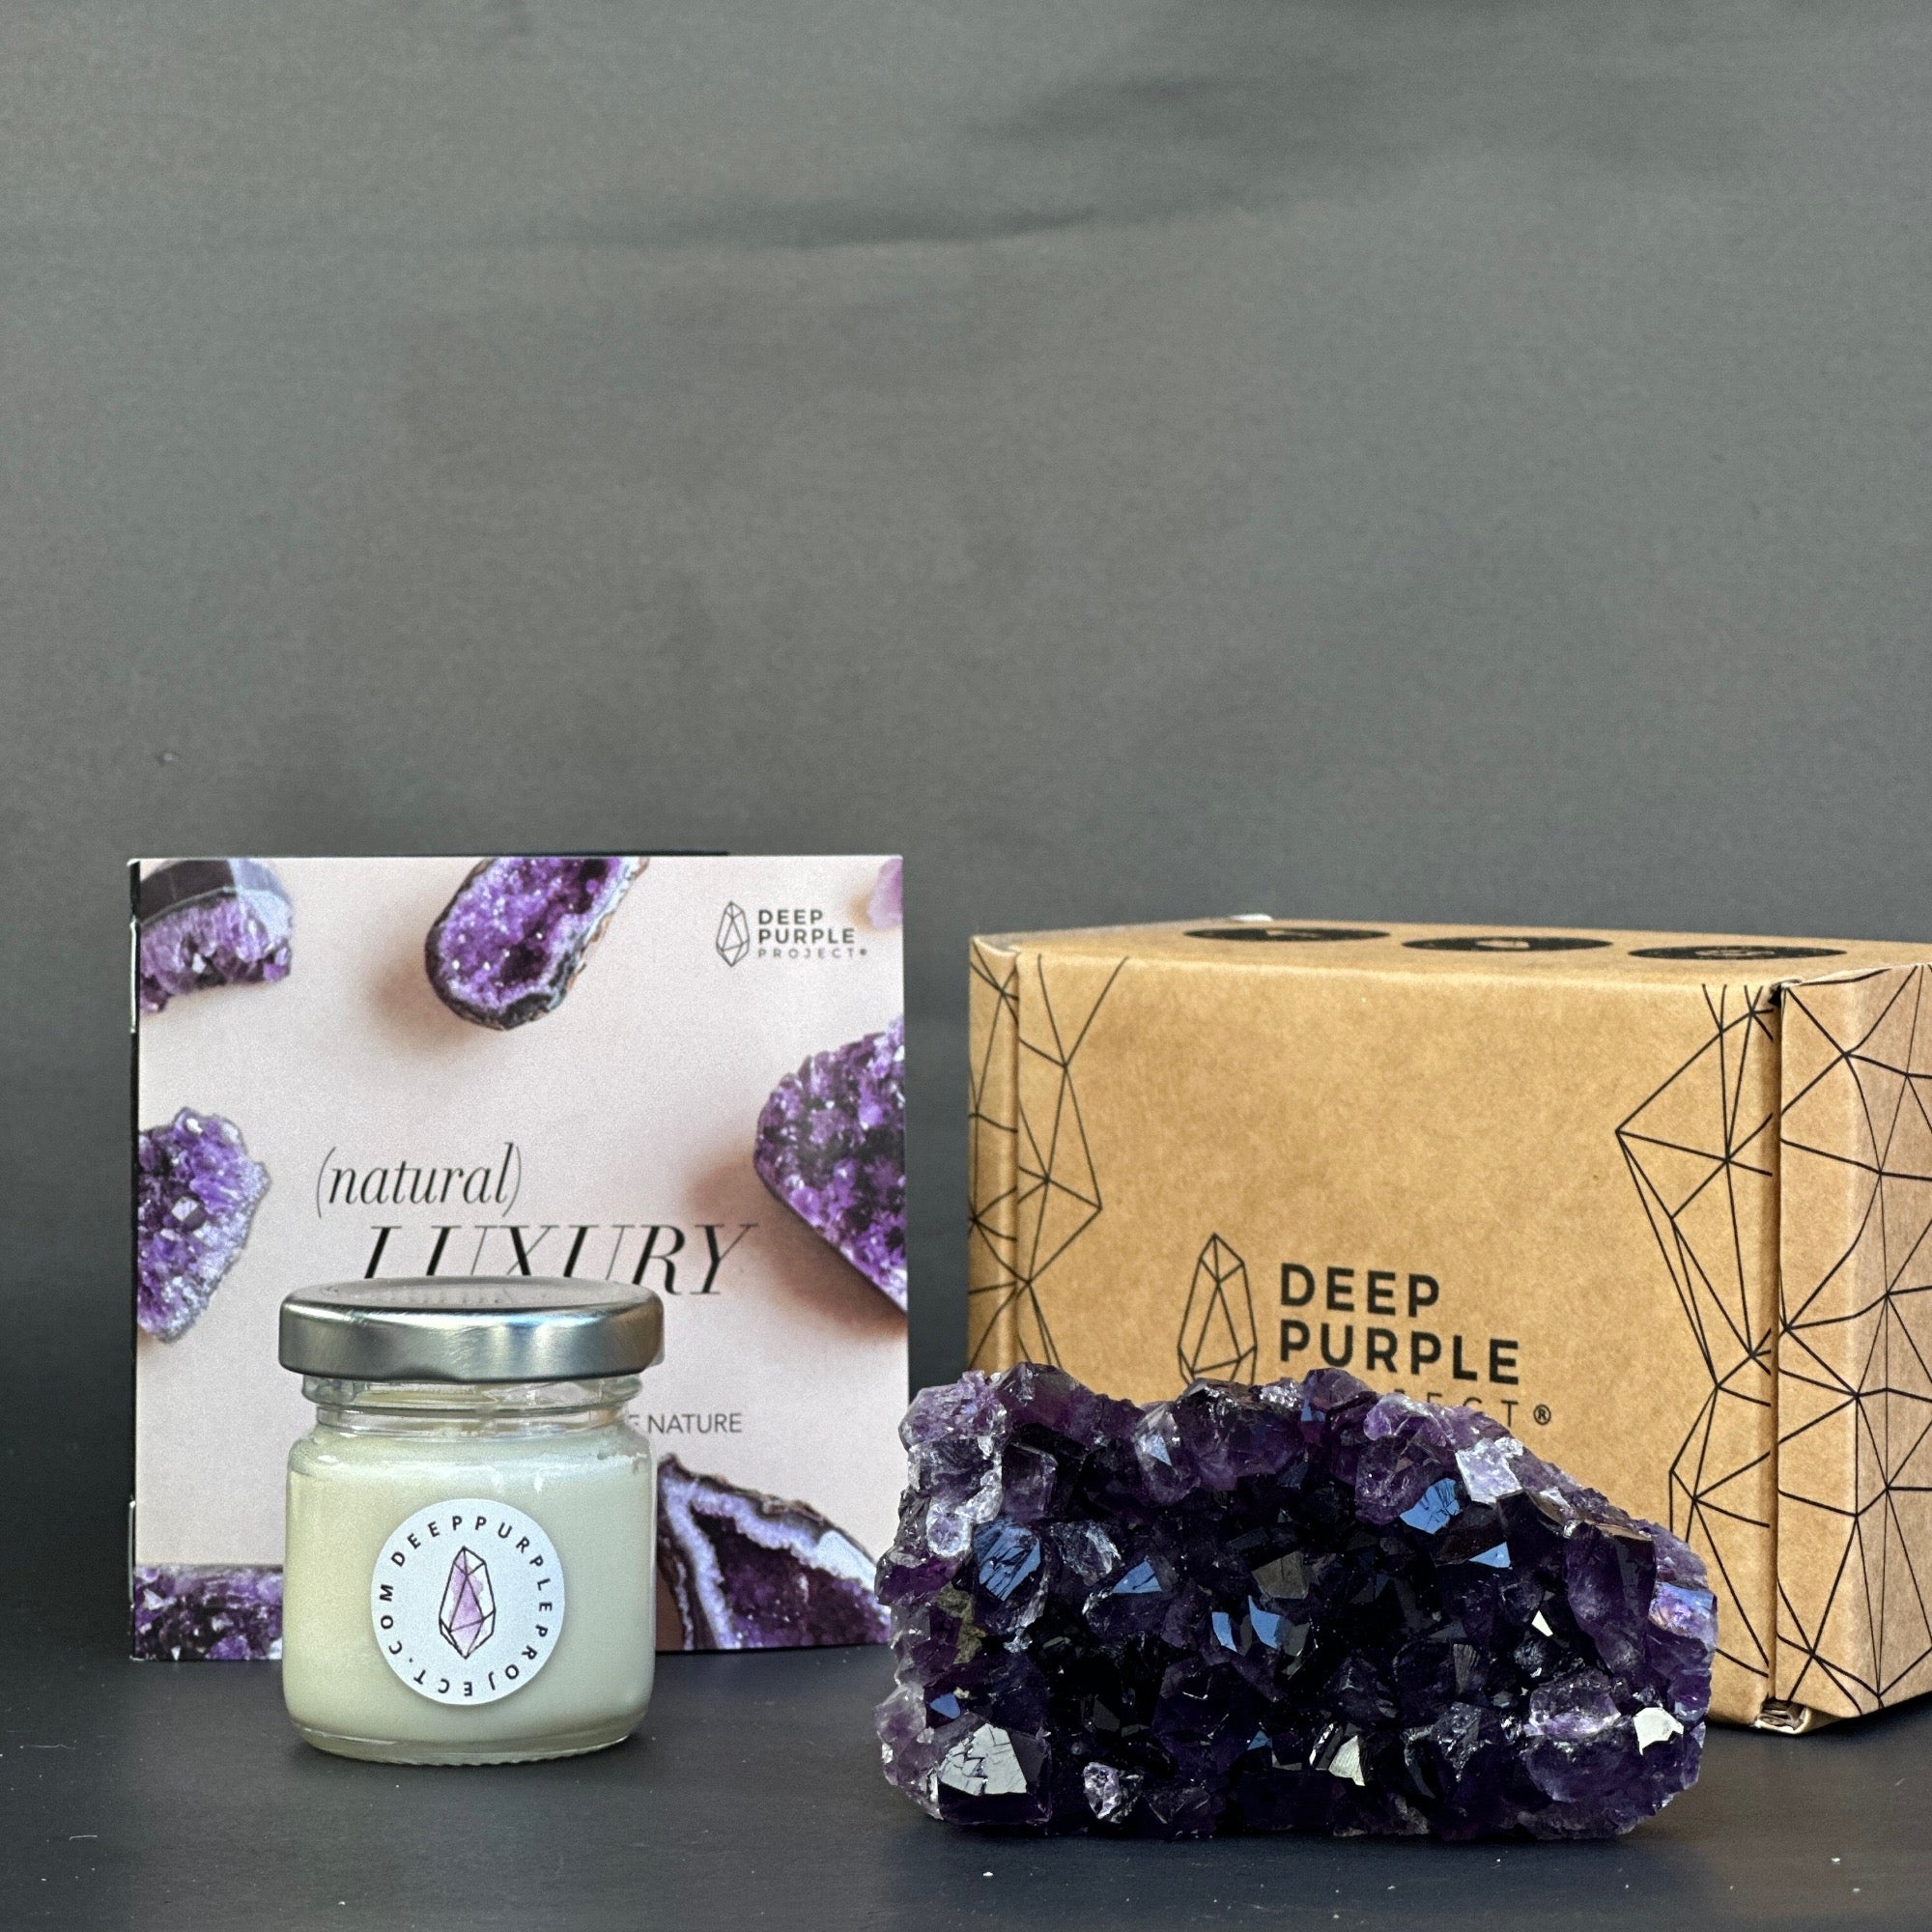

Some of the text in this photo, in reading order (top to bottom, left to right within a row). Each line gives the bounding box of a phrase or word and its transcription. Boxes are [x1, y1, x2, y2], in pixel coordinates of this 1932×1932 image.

[757, 909, 823, 925] DEEP
[757, 927, 855, 944] PURPLE
[316, 1142, 522, 1218] (natural)
[363, 1222, 759, 1295] LUXURY
[1280, 1262, 1440, 1318] DEEP
[1280, 1319, 1520, 1385] PURPLE
[647, 1412, 742, 1435] NATURE
